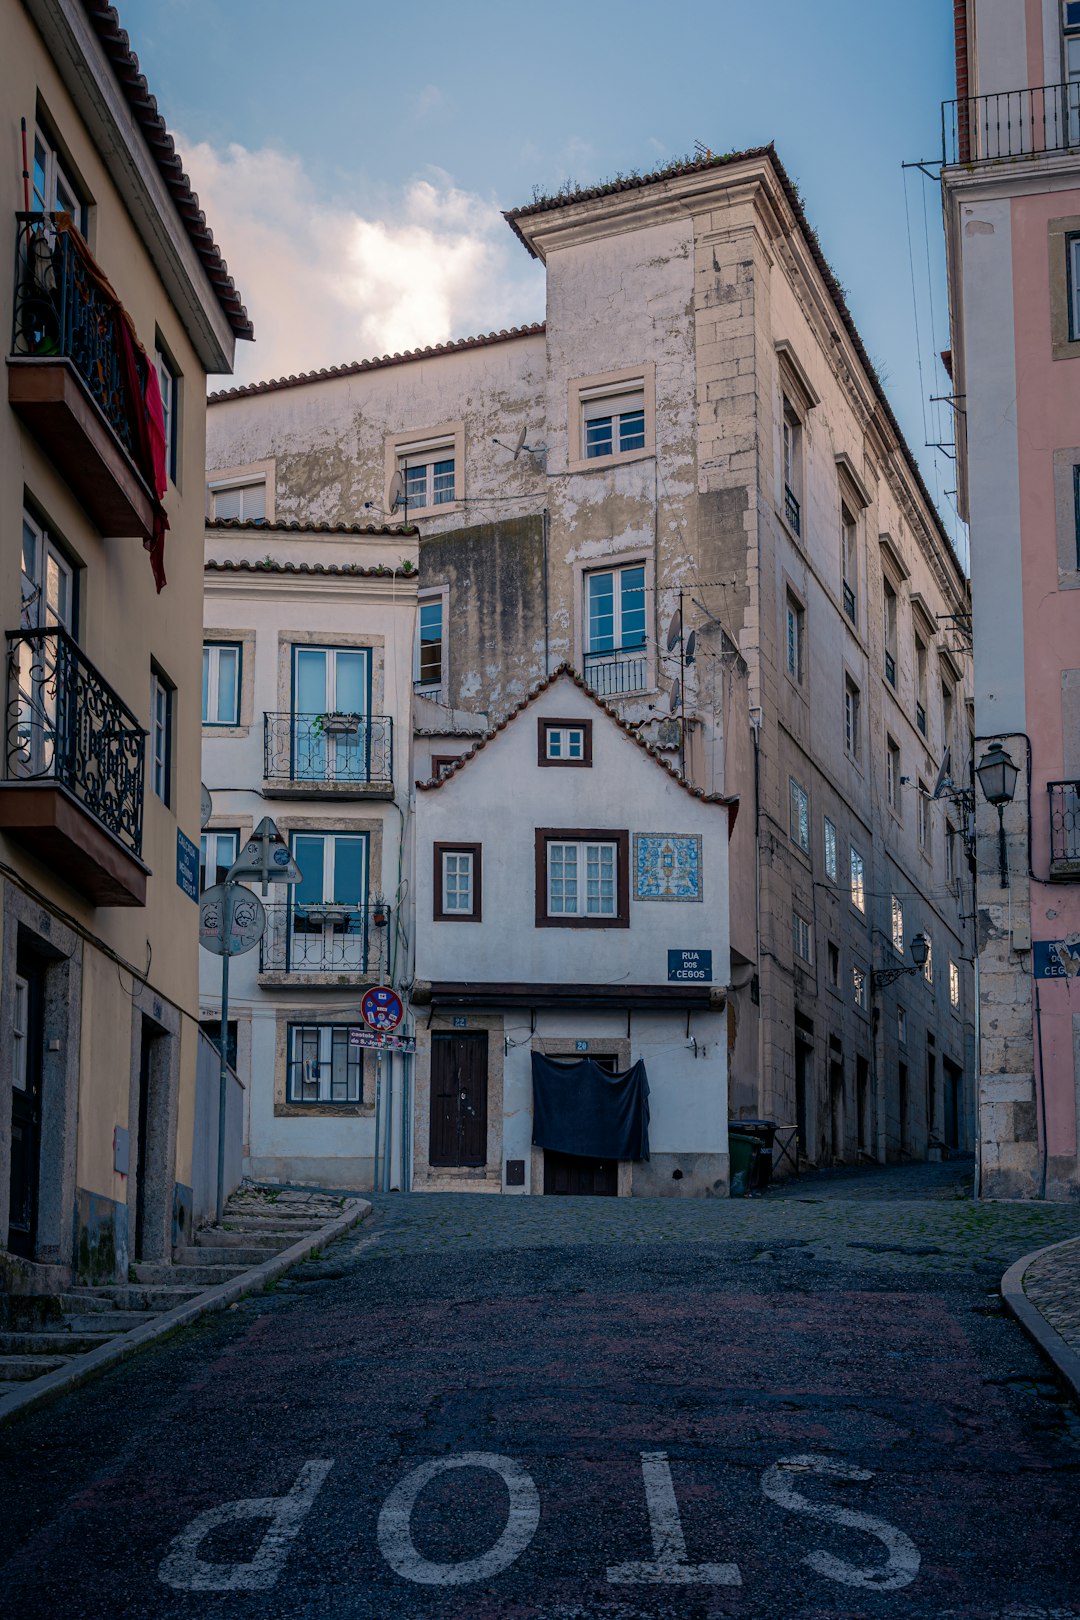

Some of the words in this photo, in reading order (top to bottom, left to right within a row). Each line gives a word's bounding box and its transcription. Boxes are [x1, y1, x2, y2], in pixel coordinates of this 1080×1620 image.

[682, 951, 700, 960] RUA
[683, 961, 698, 969] DOS
[676, 970, 705, 979] CEGOS
[455, 1018, 465, 1027] 22
[577, 1041, 587, 1050] 20
[157, 1450, 922, 1591] STOP
